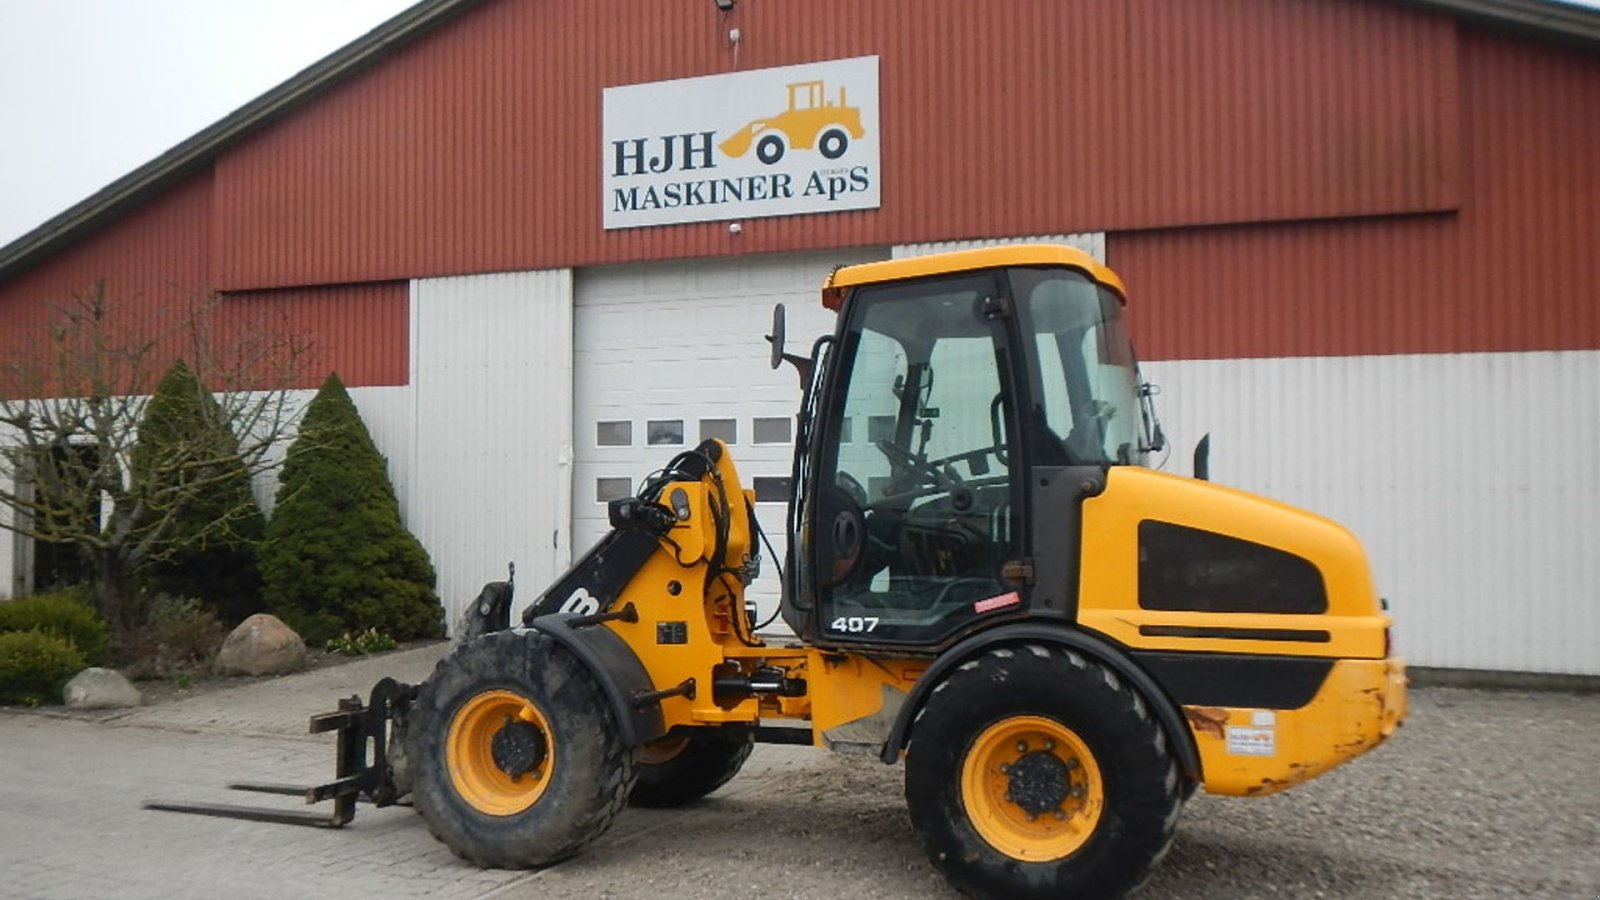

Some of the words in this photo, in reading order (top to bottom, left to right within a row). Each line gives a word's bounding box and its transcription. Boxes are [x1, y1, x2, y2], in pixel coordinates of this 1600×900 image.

[611, 130, 717, 177] HJH
[612, 173, 794, 212] MASKINER
[802, 165, 870, 201] ApS
[831, 616, 880, 633] 407
